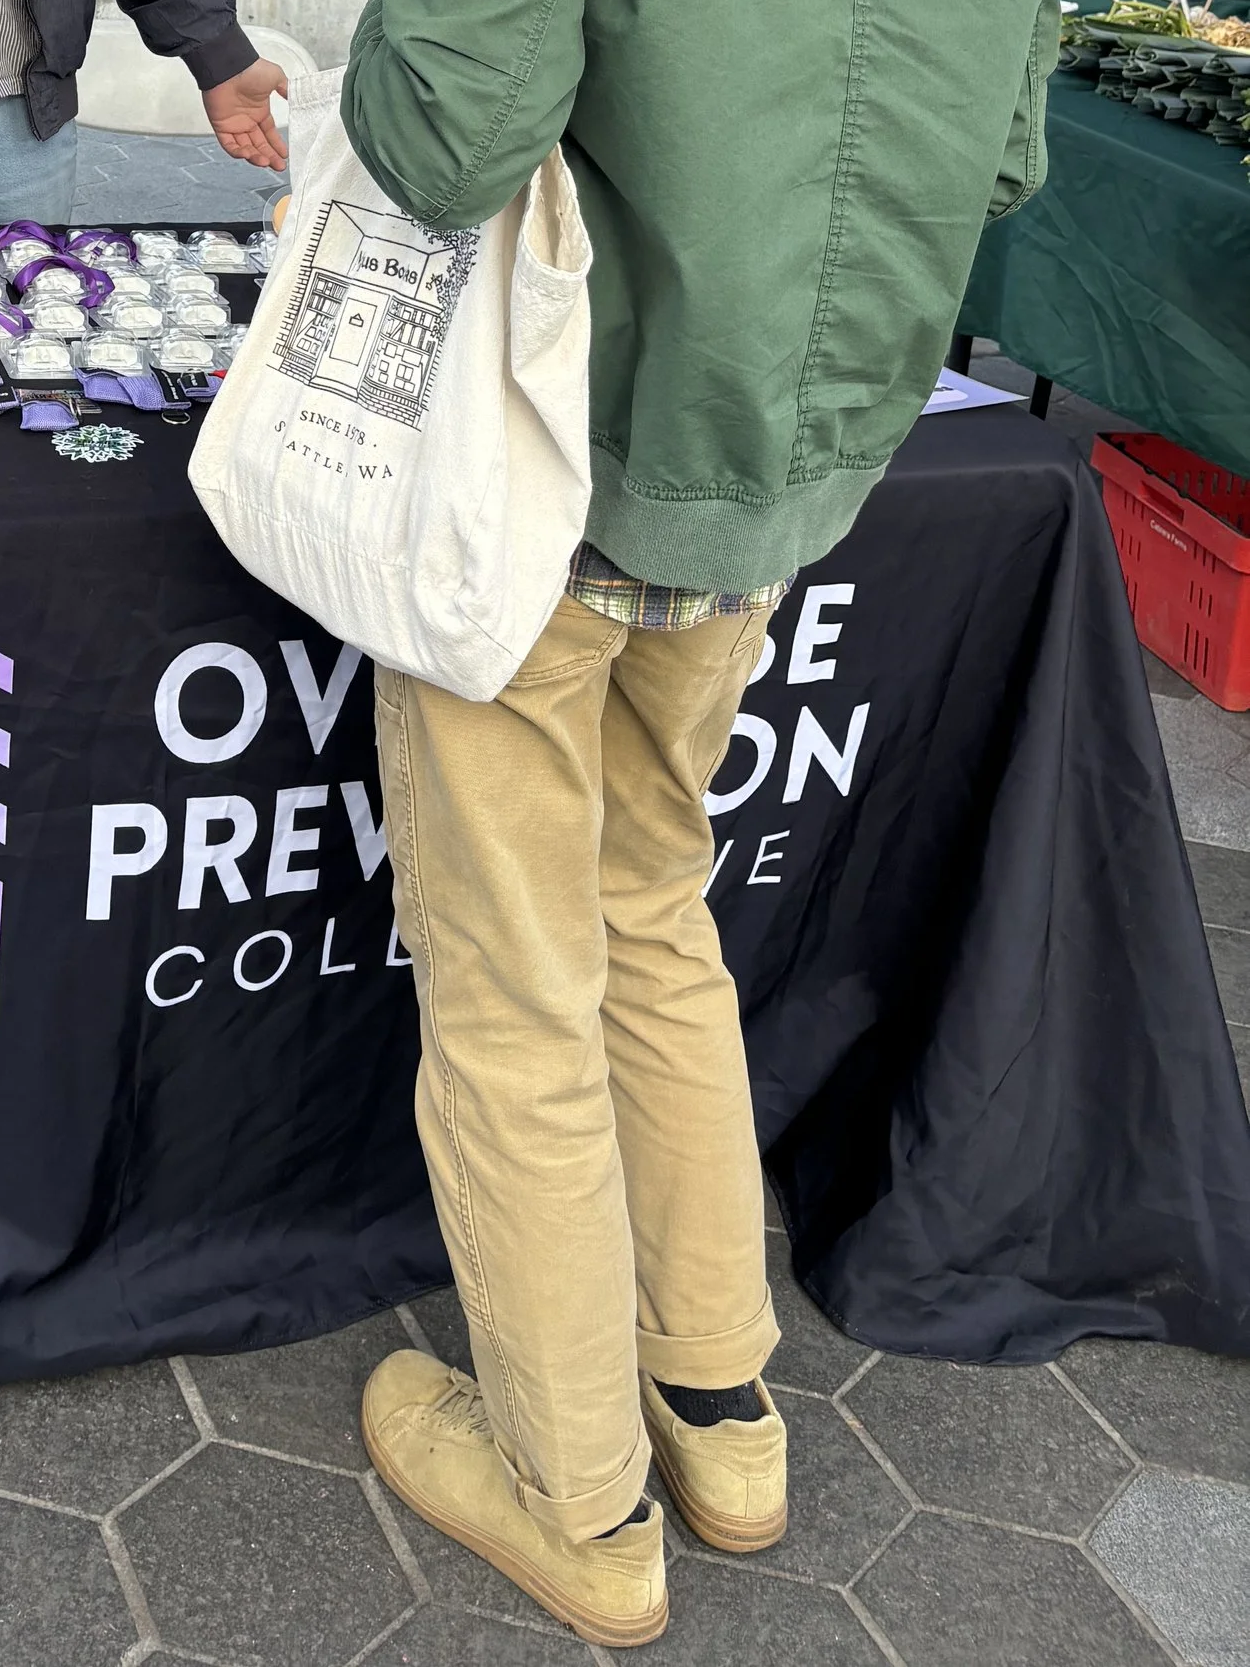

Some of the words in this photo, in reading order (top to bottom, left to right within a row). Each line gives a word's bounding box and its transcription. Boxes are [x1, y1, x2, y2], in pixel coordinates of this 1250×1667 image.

[300, 410, 342, 434] SINCE
[274, 420, 349, 478] SATTLE,
[358, 464, 393, 480] WA
